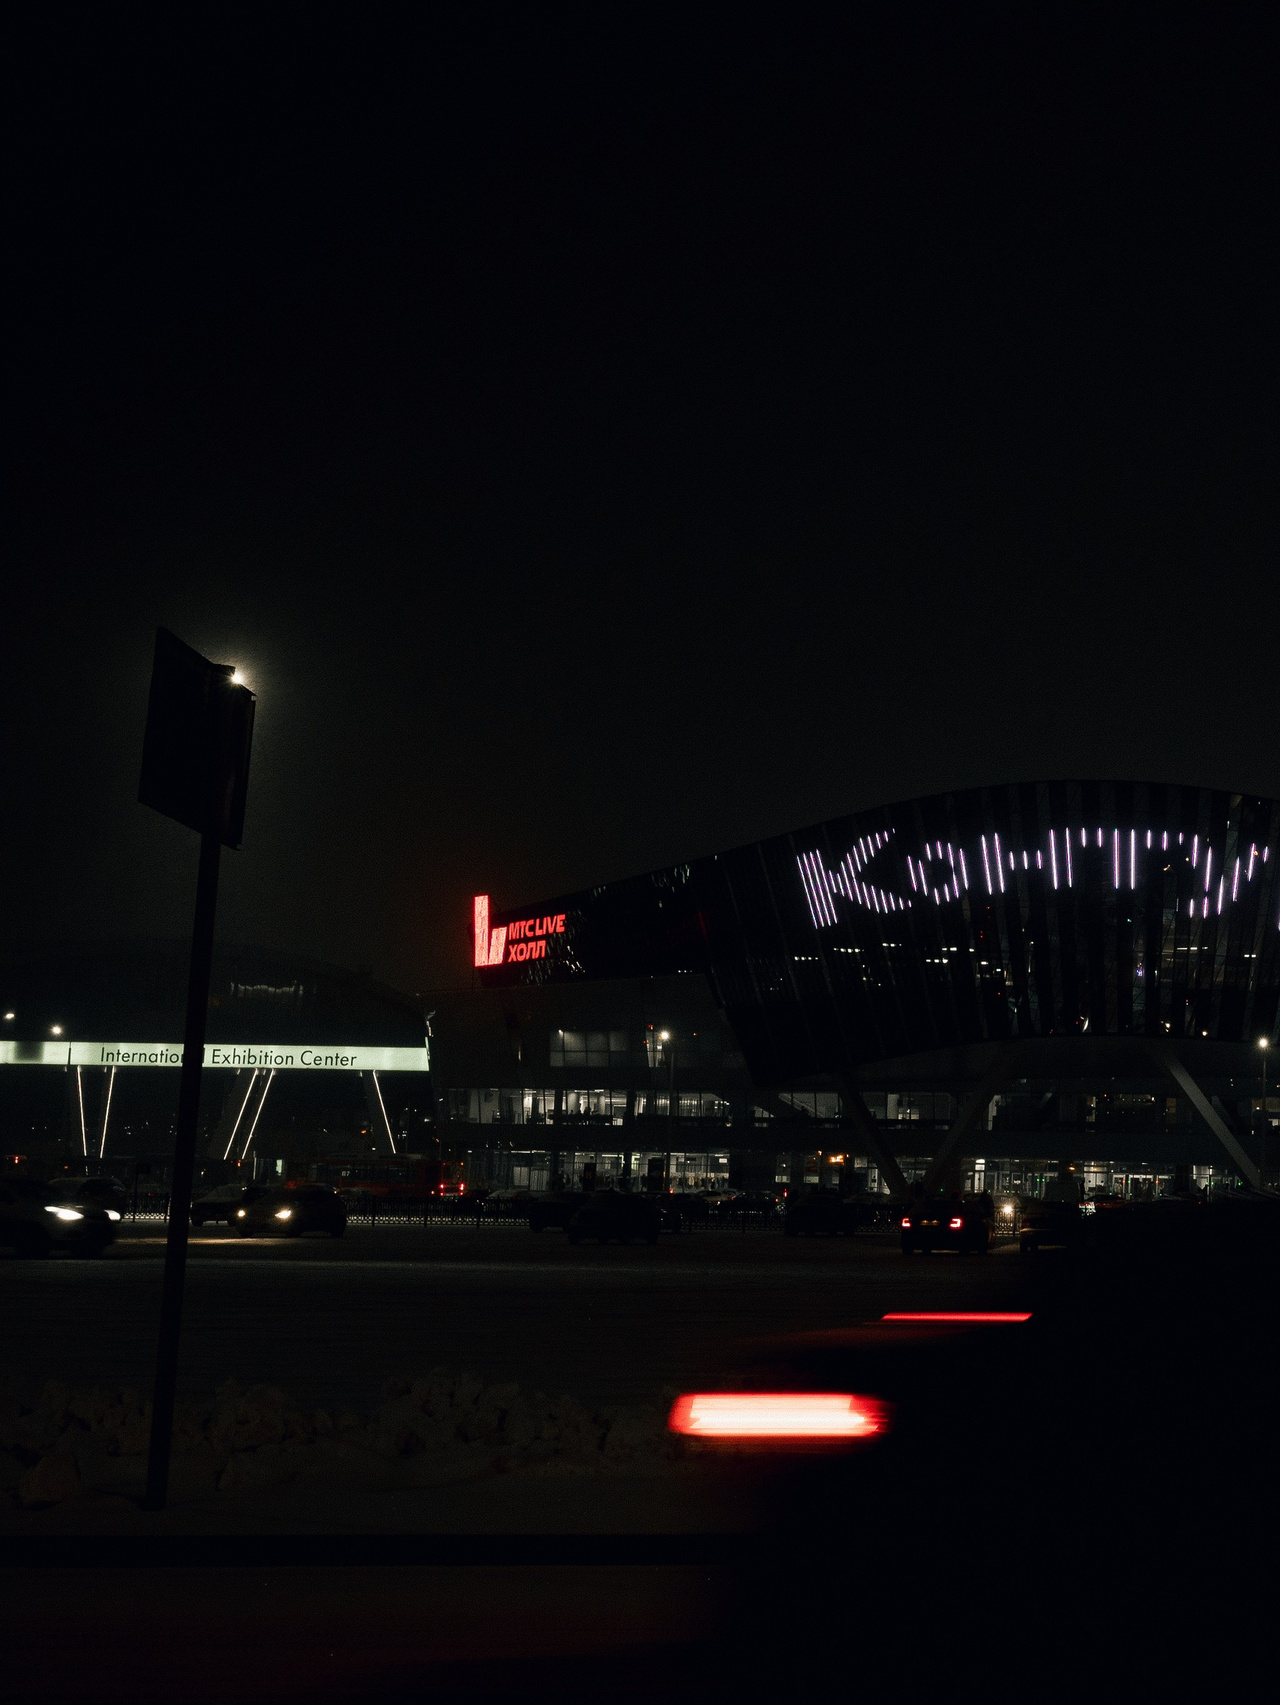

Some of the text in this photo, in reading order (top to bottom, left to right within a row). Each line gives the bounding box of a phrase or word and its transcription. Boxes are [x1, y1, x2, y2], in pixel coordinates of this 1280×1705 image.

[535, 914, 566, 936] LIVE
[508, 940, 546, 962] ХОЛЛ
[211, 1047, 294, 1066] Exhibition
[300, 1050, 358, 1068] Center
